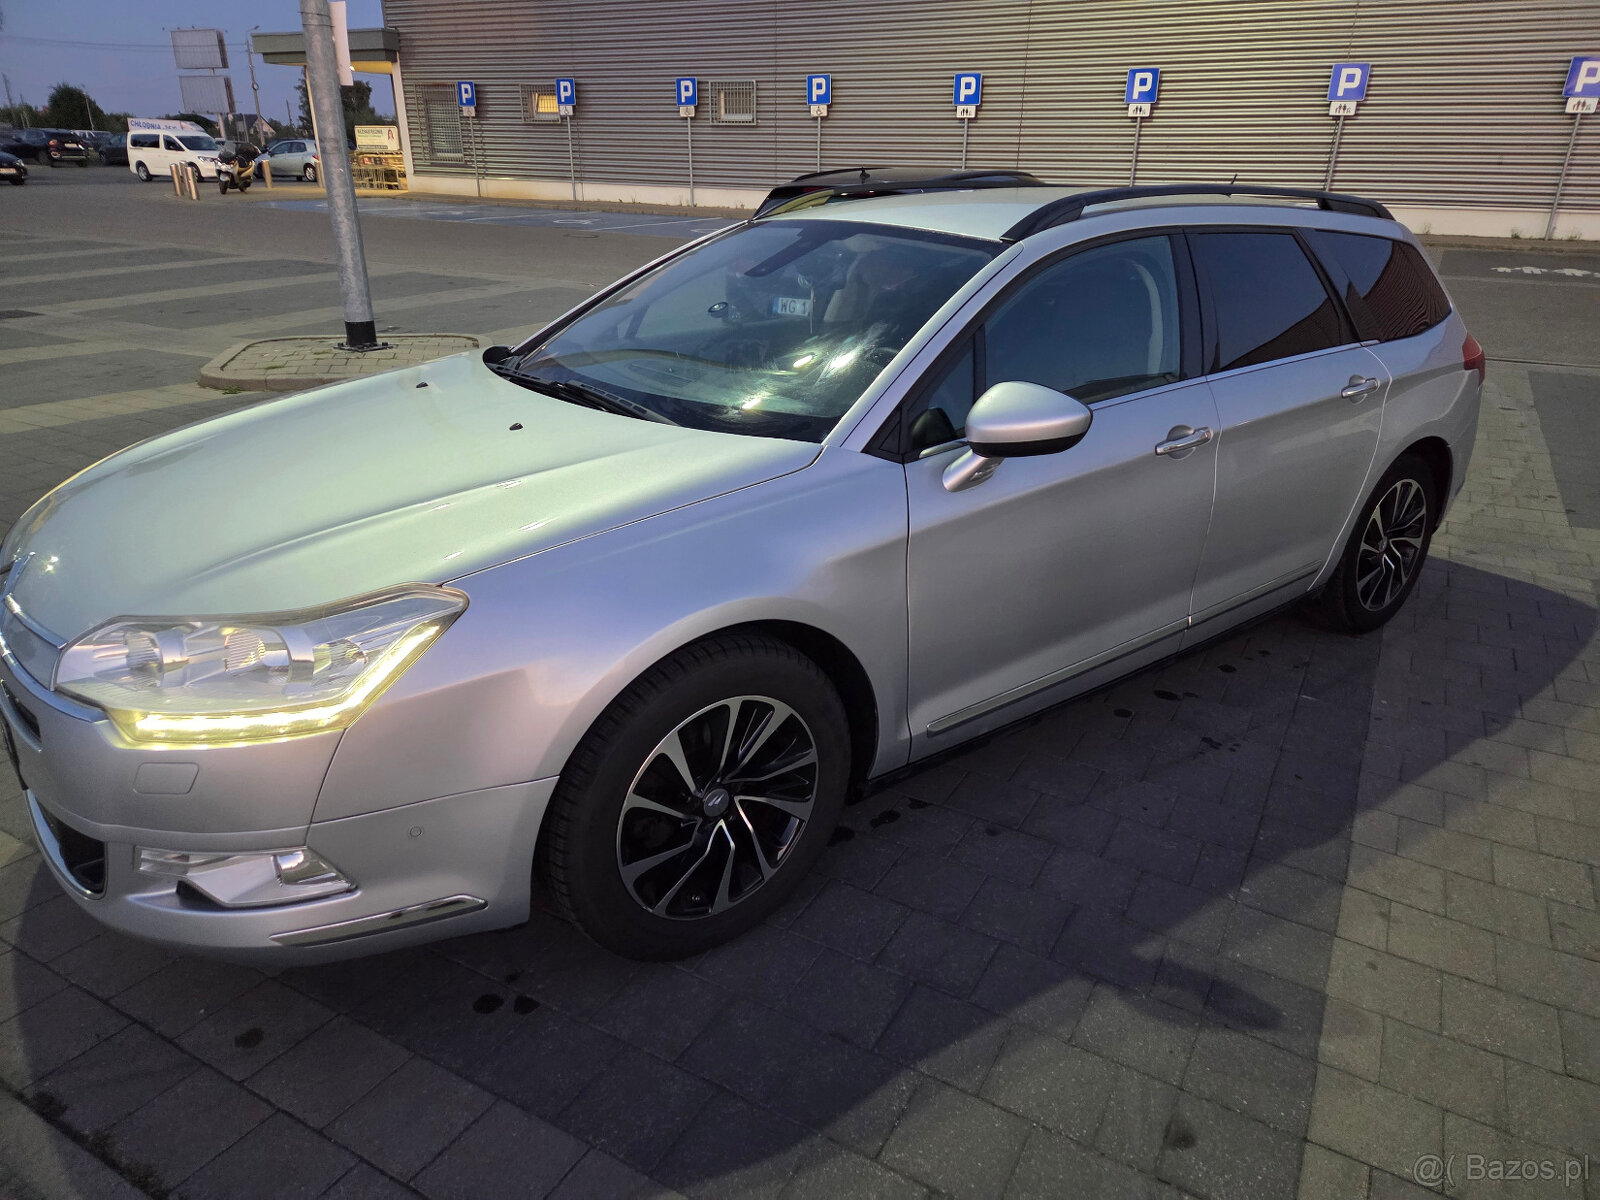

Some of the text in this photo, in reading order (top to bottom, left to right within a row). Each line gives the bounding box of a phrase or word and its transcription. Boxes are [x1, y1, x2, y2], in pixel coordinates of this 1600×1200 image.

[959, 76, 976, 101] P
[1132, 72, 1153, 99] P
[1337, 67, 1362, 96] P
[1575, 61, 1600, 92] P
[461, 83, 472, 103] P
[560, 81, 571, 102] P
[680, 80, 693, 103] P
[812, 77, 826, 101] P
